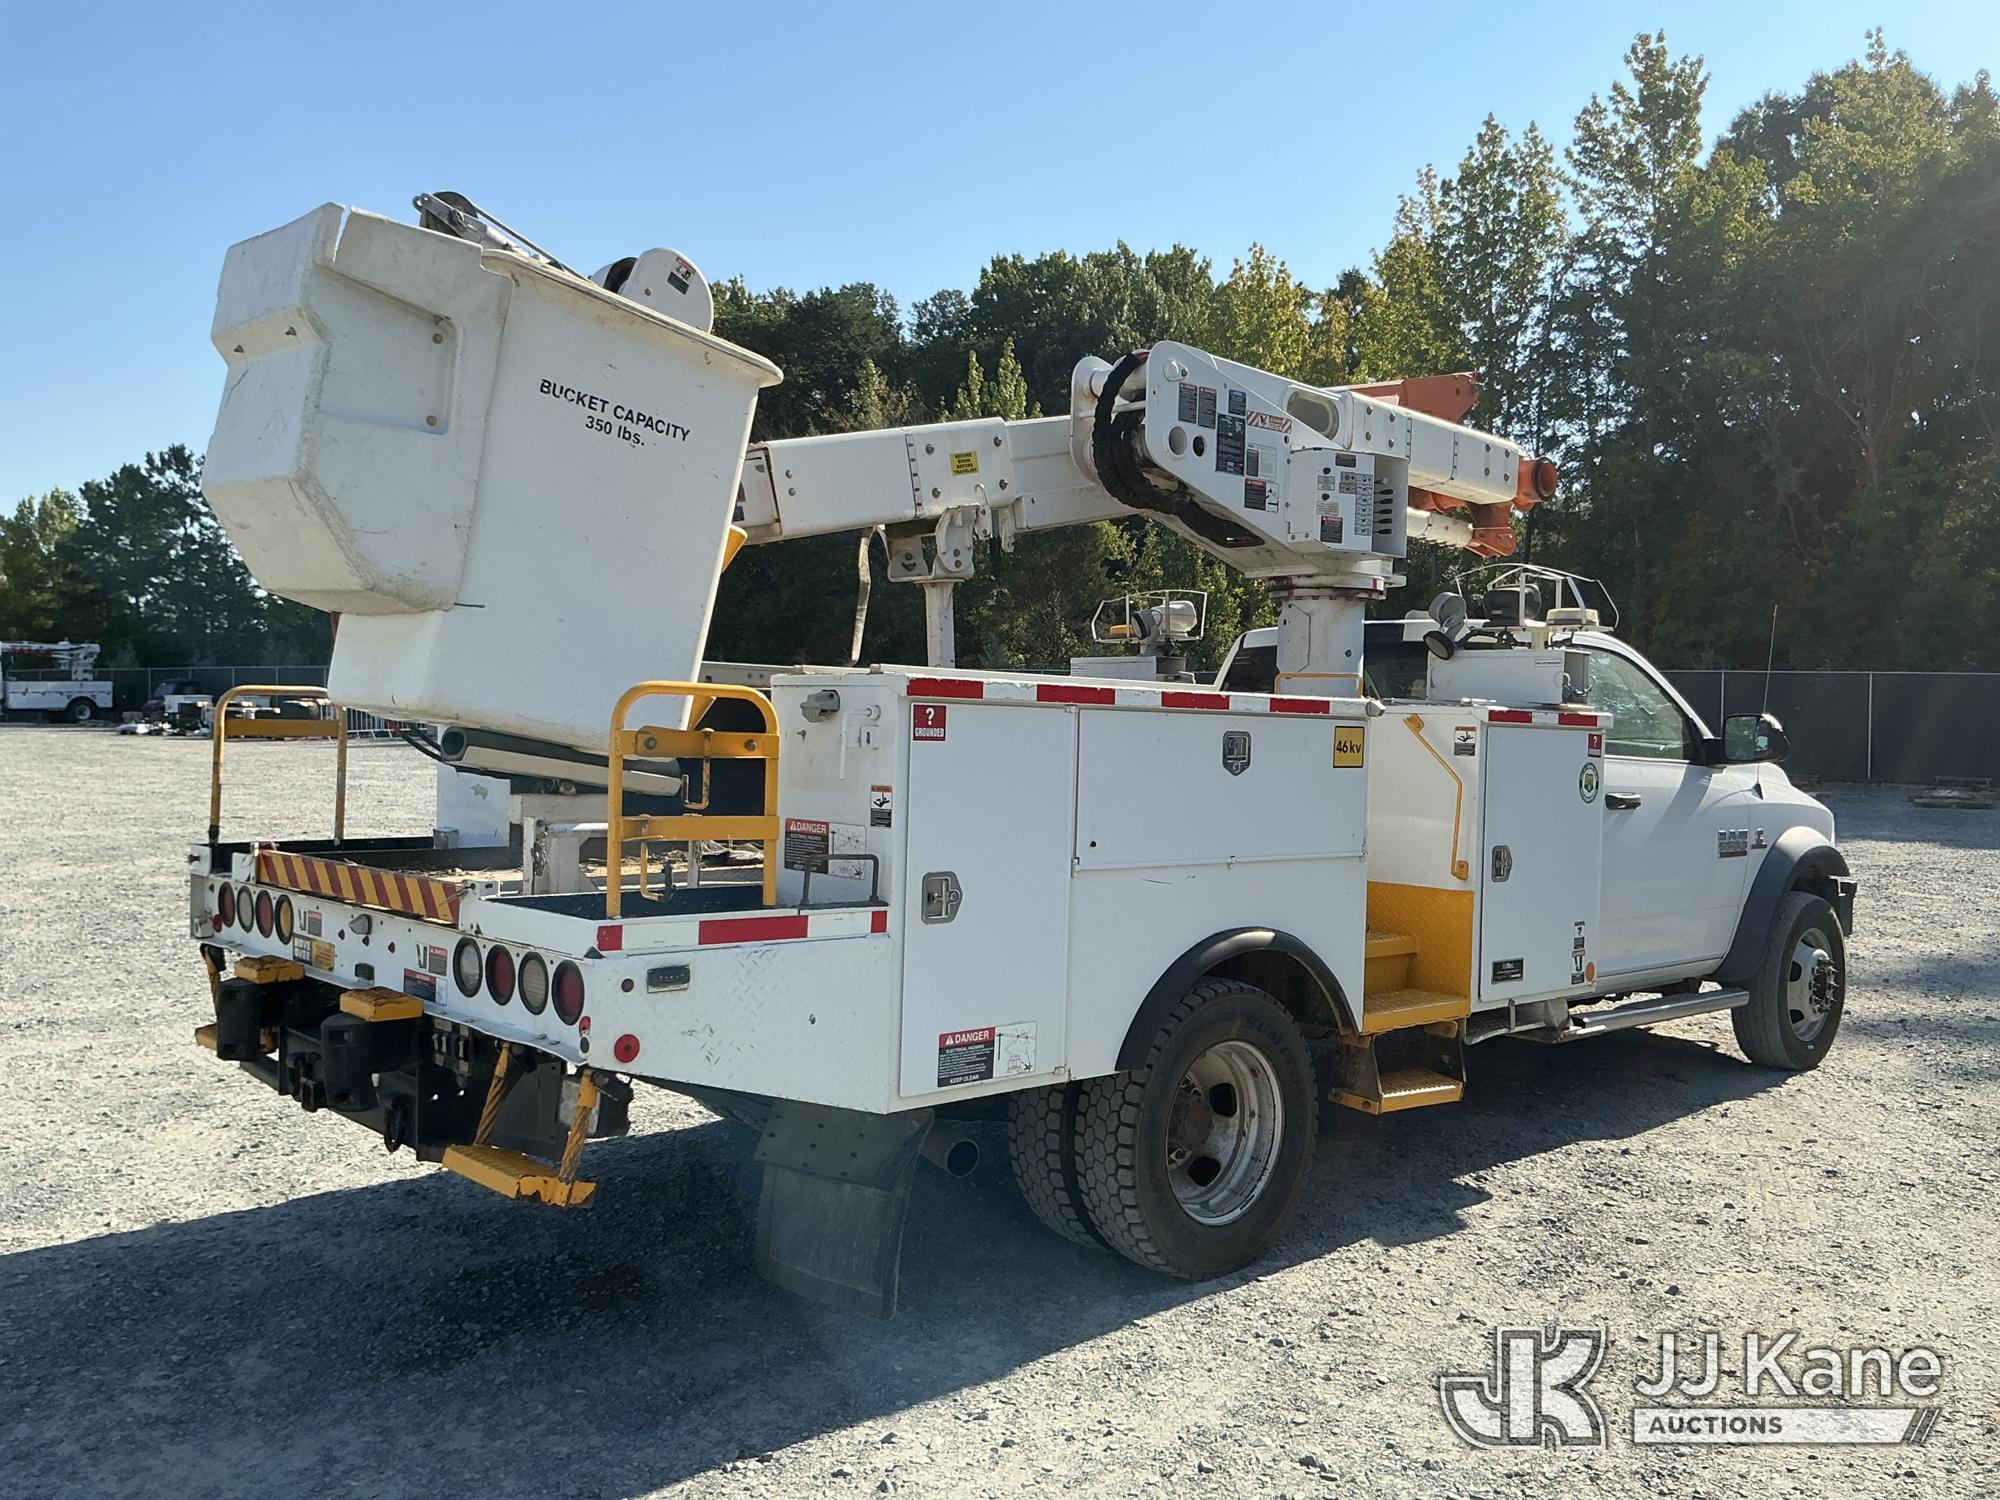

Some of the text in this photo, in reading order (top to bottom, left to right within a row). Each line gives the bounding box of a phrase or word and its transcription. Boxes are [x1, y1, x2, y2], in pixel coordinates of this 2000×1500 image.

[539, 378, 690, 442] BUCKET CAPACITY
[585, 415, 645, 446] 350 lbs.
[1336, 740, 1348, 754] 46
[796, 821, 827, 835] DANGER
[954, 1030, 989, 1044] DANGER
[949, 1074, 979, 1084] KEEP CLEAR
